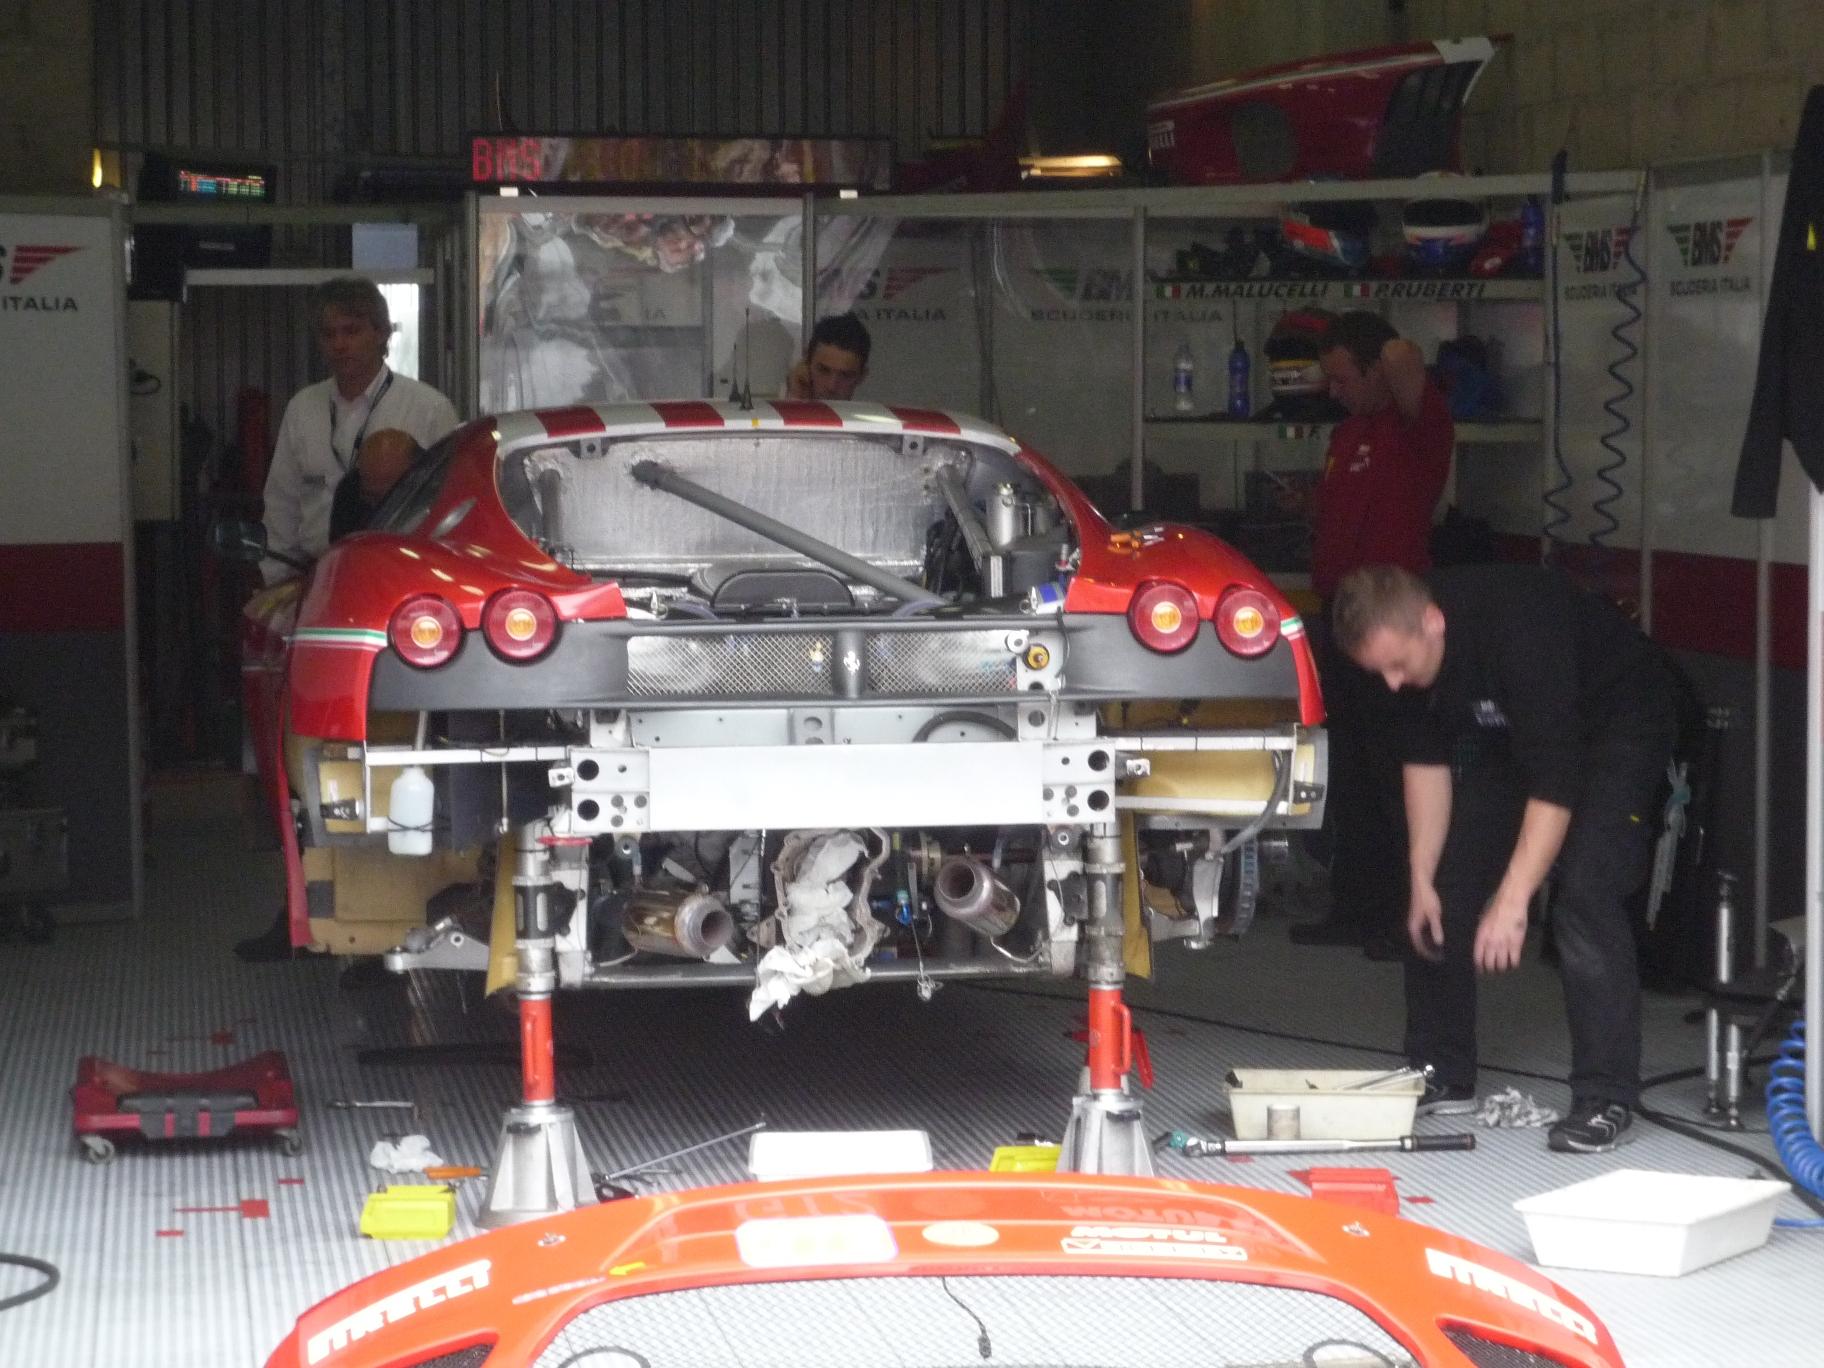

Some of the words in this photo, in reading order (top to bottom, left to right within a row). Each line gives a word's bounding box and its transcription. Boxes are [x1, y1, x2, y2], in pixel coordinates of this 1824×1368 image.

[471, 138, 542, 182] BMS
[2, 296, 78, 312] ITALIA
[875, 308, 947, 321] ITALIA
[1071, 1226, 1228, 1244] MOTUL
